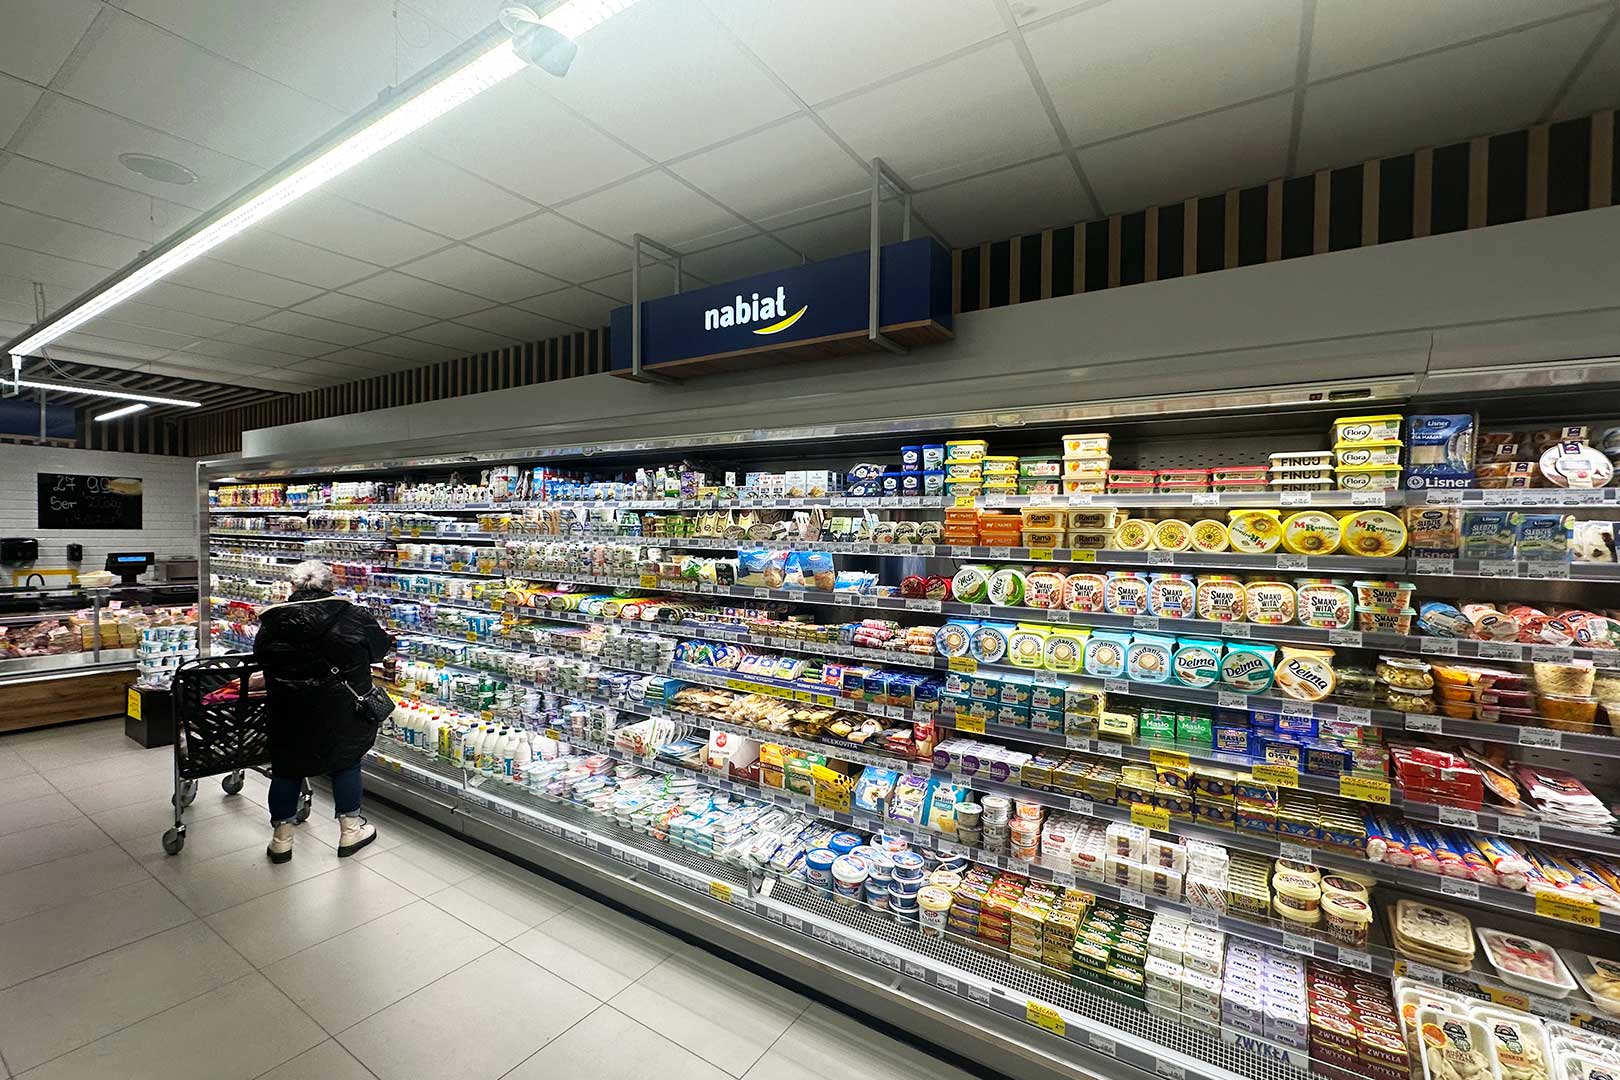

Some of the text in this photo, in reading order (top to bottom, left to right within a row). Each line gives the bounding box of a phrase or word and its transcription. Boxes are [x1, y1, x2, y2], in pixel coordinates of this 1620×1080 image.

[704, 286, 787, 331] nabiał
[1346, 428, 1367, 436] Flora
[1425, 477, 1471, 488] Lisner
[1030, 514, 1050, 522] Rama
[1078, 514, 1100, 522] Rama
[1032, 534, 1052, 542] Rama
[1198, 541, 1214, 550] MR
[1034, 582, 1052, 590] SMAKO
[1074, 582, 1094, 592] SMAKO
[1118, 587, 1138, 596] SMAKO
[1162, 588, 1182, 596] SMAKO
[1210, 590, 1234, 600] SMAKO
[1372, 589, 1397, 598] SMAKO
[1258, 592, 1282, 602] SMAKO
[1312, 597, 1337, 606] SMAKO
[1262, 600, 1278, 608] WITA
[1315, 604, 1334, 612] WITA
[1374, 614, 1398, 623] SMAKO
[1178, 658, 1215, 669] Delma
[1224, 659, 1262, 678] Delma
[1289, 659, 1328, 690] Delma
[1146, 720, 1170, 728] Masło
[1182, 722, 1206, 731] Masło
[822, 736, 858, 749] MLEKOVITA
[1220, 734, 1245, 742] MASŁO
[1268, 752, 1298, 761] MASŁO
[1572, 913, 1594, 924] 5.89
[1078, 954, 1098, 966] PALMA
[1116, 952, 1137, 964] PALMA
[1315, 978, 1344, 989] ZWYKŁA
[1316, 995, 1346, 1007] ZWYKŁA
[1318, 1010, 1349, 1024] ZWYKŁA
[1360, 1010, 1391, 1022] ZWYKŁA
[1319, 1030, 1350, 1046] ZWYKŁA
[1235, 1034, 1290, 1062] ZWYKŁA
[1320, 1047, 1352, 1062] ZWYKŁA
[1367, 1048, 1401, 1063] ZWYKŁA
[1368, 1064, 1401, 1078] ZWYKŁA
